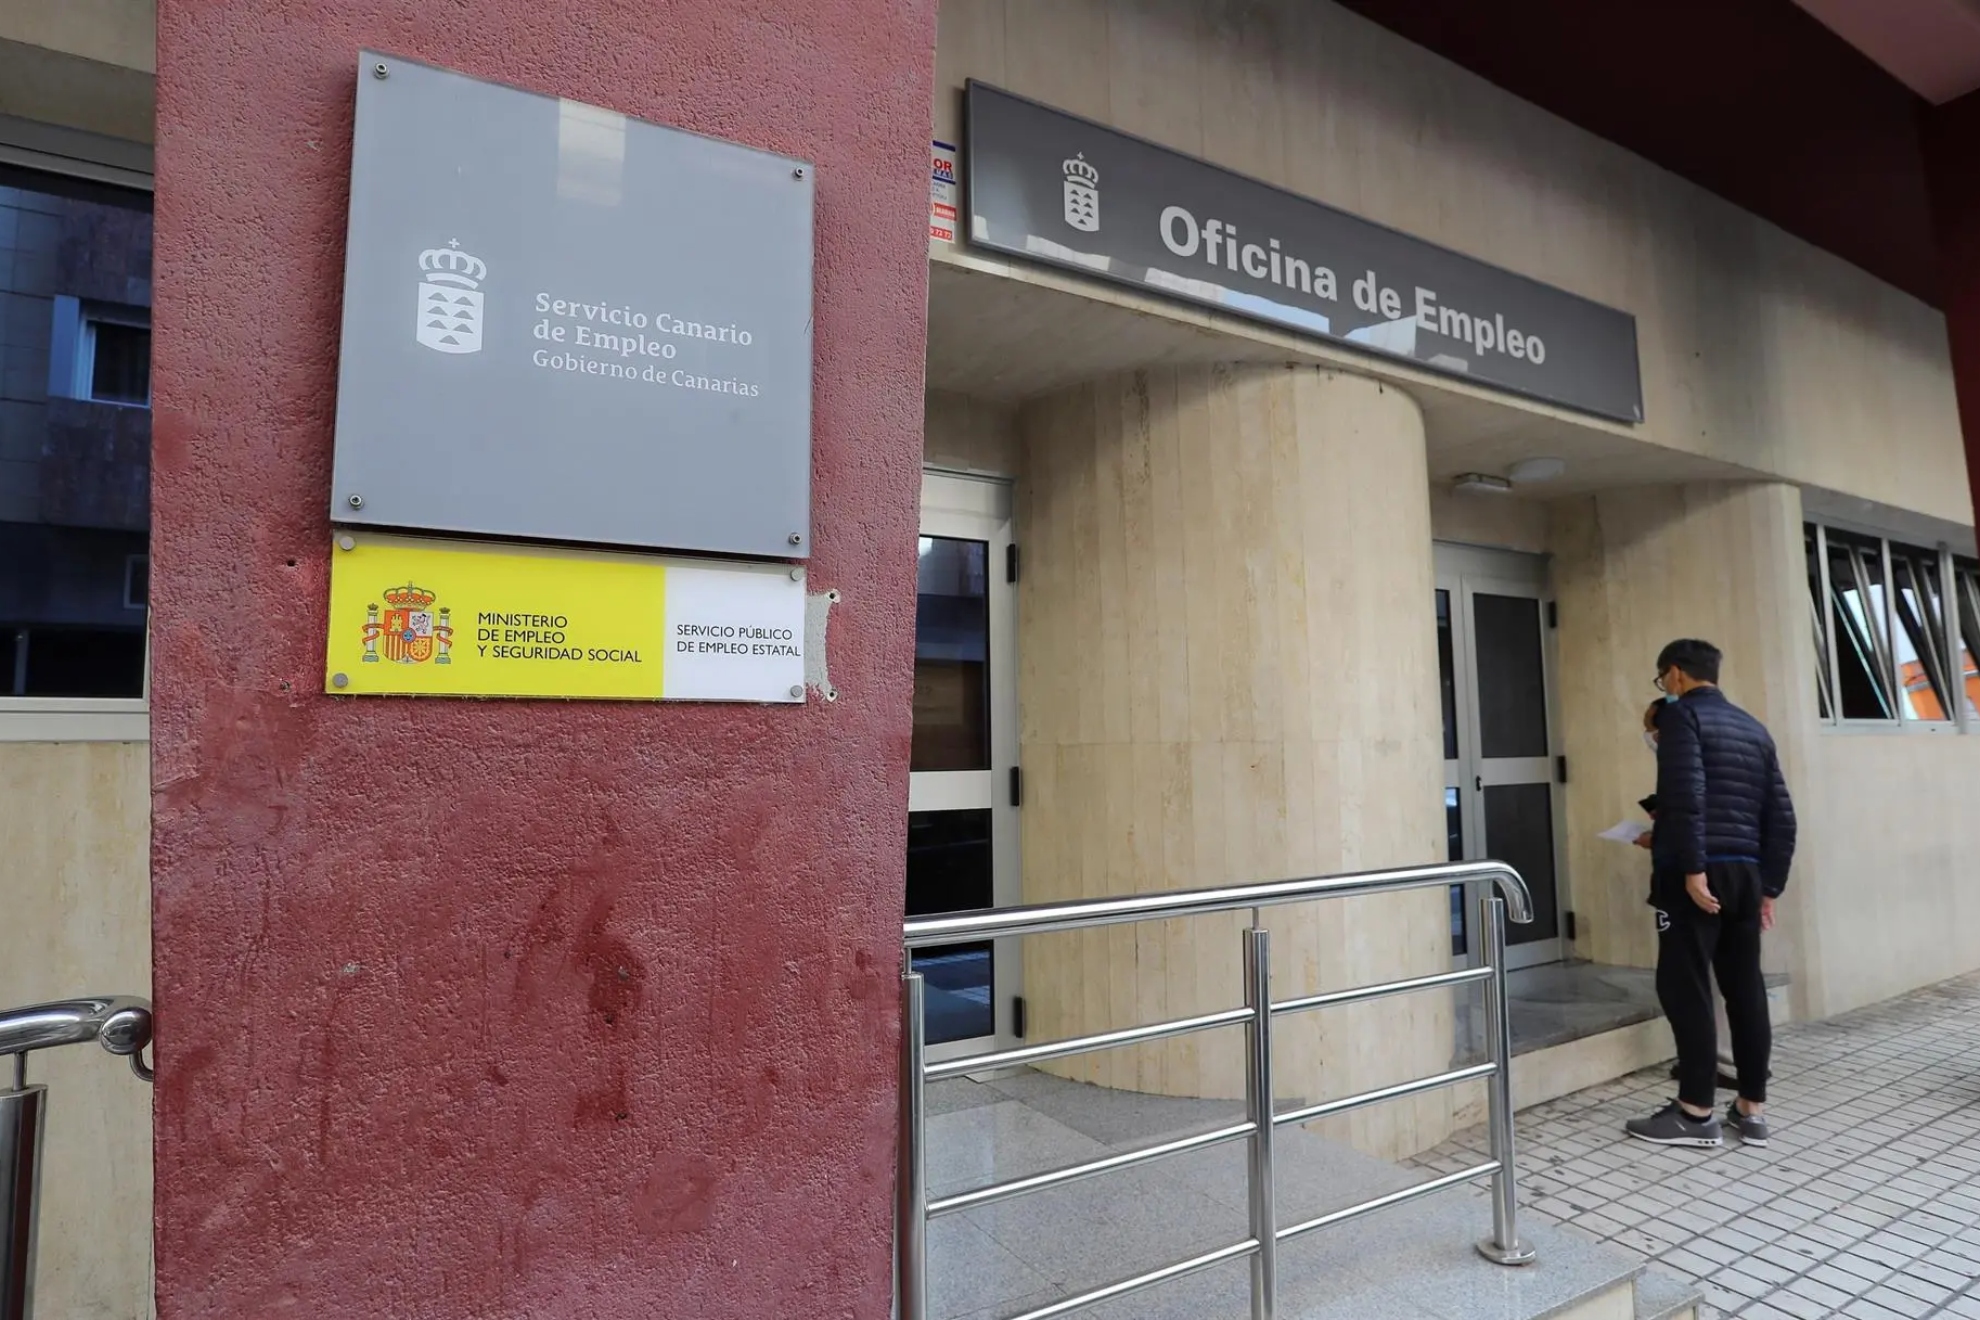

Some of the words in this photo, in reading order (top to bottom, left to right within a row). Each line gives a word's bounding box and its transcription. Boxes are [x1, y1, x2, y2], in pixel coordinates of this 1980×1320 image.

[1159, 205, 1337, 301] Oficina
[1352, 270, 1402, 319] de
[1415, 286, 1546, 366] Empleo
[535, 293, 648, 329] Servicio
[656, 313, 753, 346] Canario
[533, 319, 566, 343] de
[575, 325, 677, 360] Empleo
[533, 349, 638, 380] Gobierno
[642, 364, 667, 384] de
[671, 370, 759, 398] Canarias
[478, 612, 568, 629] MINISTERIO
[477, 628, 499, 642] DE
[504, 629, 565, 644] EMPLEO
[676, 624, 735, 638] SERVICIO
[738, 625, 793, 641] PÚBLICO
[477, 645, 488, 657] Y
[492, 645, 583, 661] SEGURIDAD
[588, 648, 643, 663] SOCIAL
[676, 641, 695, 653] DE
[698, 642, 749, 655] EMPLEO
[752, 644, 801, 657] ESTATAL
